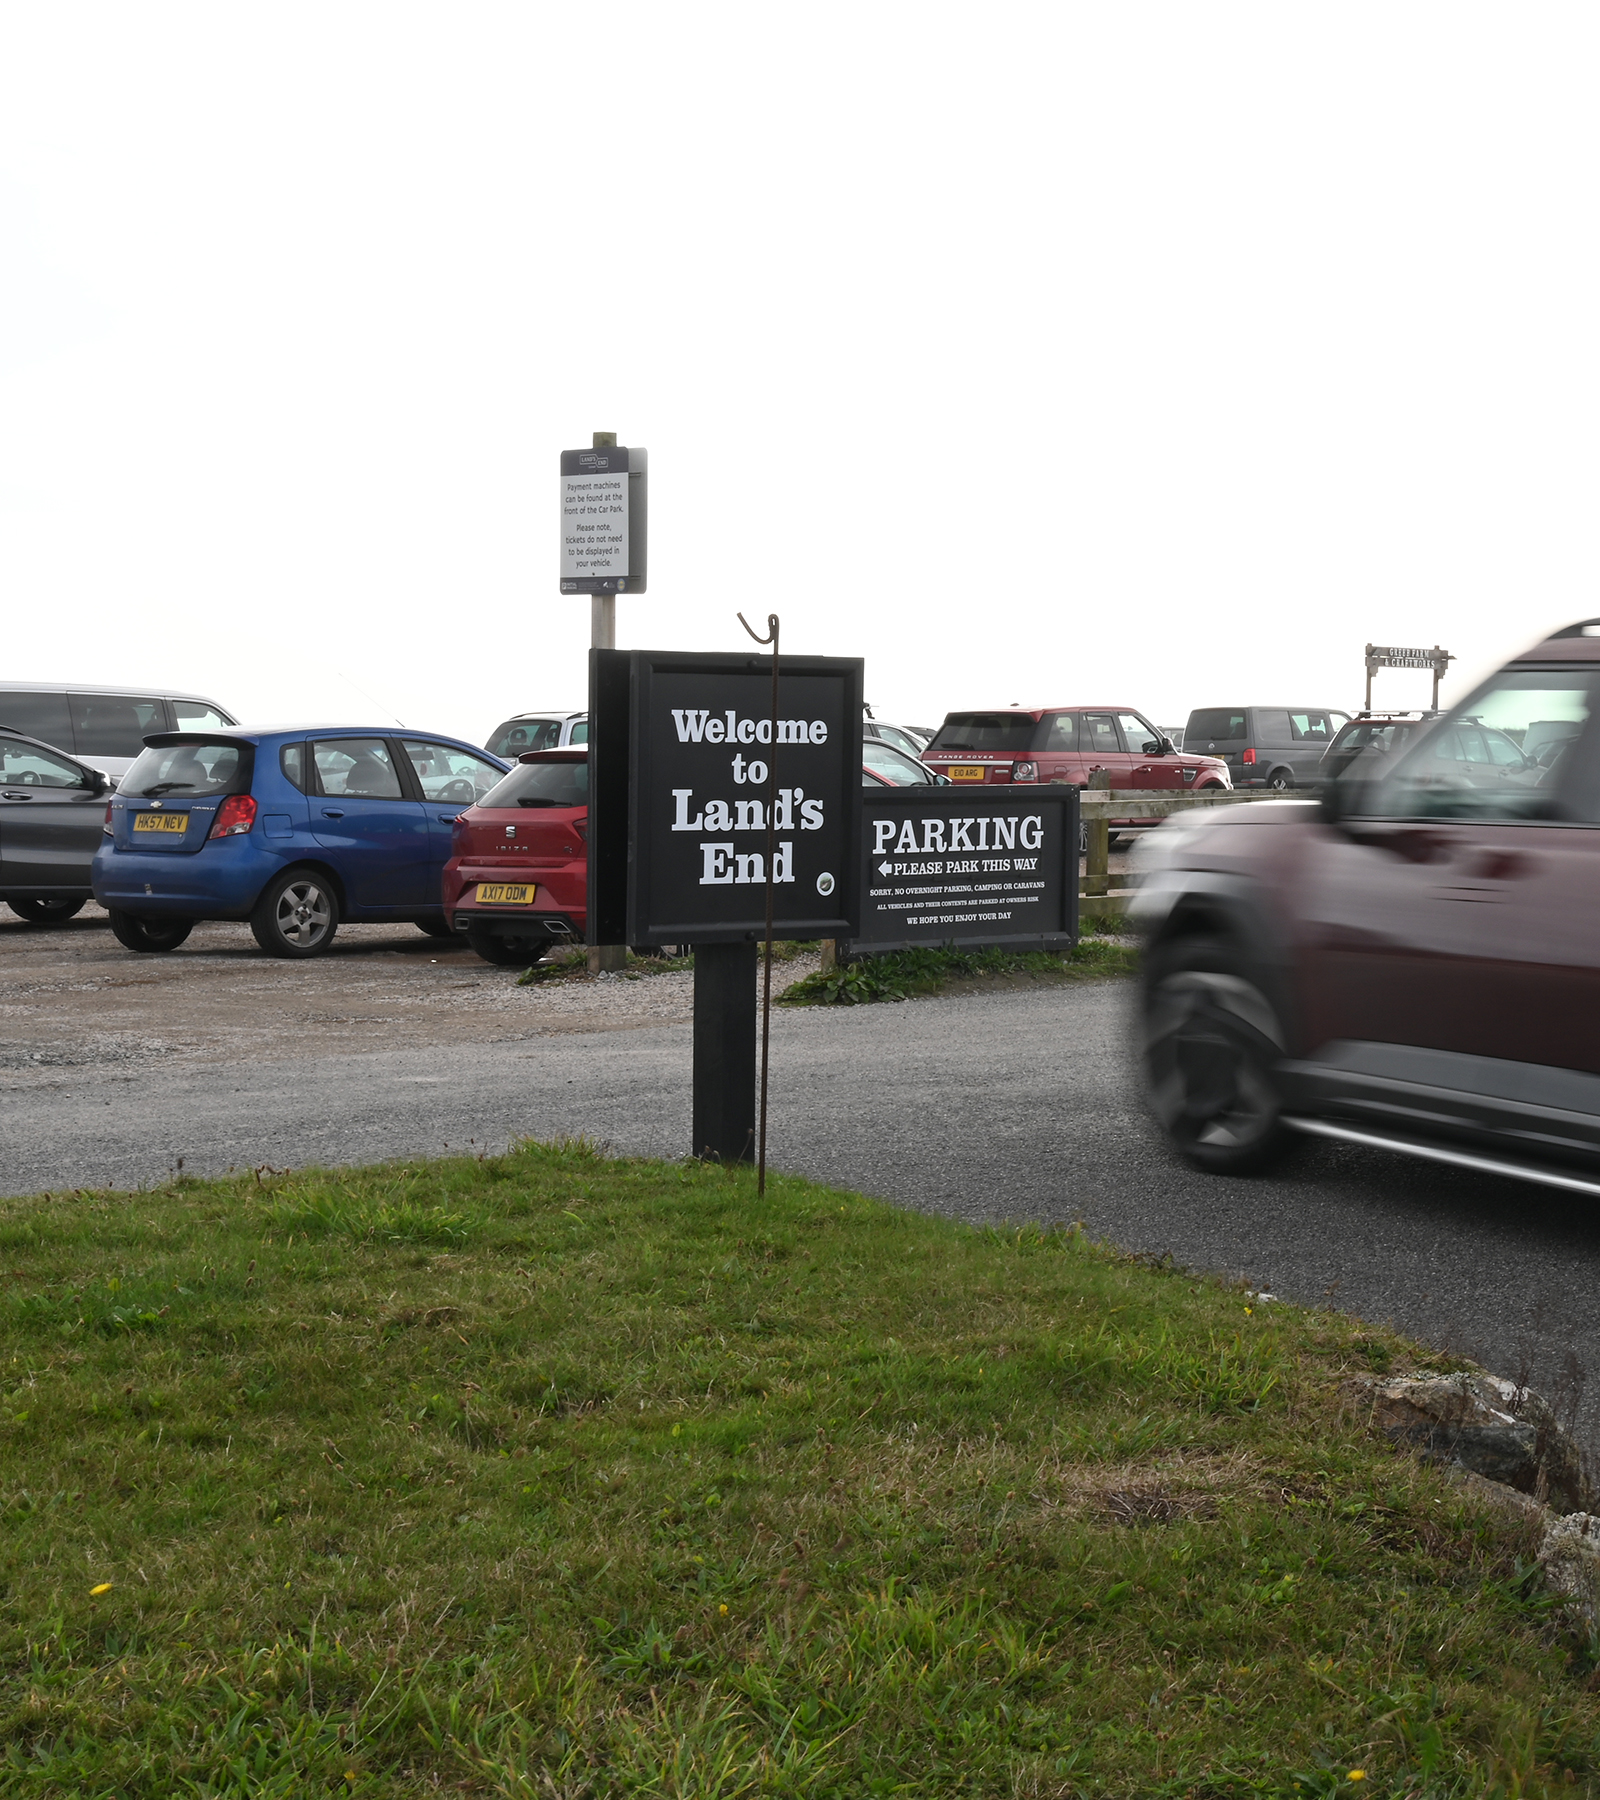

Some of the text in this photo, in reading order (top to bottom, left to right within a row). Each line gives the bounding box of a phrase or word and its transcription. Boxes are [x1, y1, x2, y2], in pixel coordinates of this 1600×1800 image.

[568, 481, 620, 492] Payment machines
[578, 494, 585, 502] be
[586, 494, 603, 502] found
[564, 506, 578, 514] front
[580, 506, 586, 514] of
[588, 506, 597, 514] the
[610, 504, 624, 512] Park.
[566, 536, 586, 544] tickets
[587, 535, 594, 543] do
[608, 534, 622, 542] need
[576, 547, 584, 556] be
[585, 546, 612, 557] displayed
[614, 546, 620, 554] in
[576, 558, 612, 568] your vehicle.
[1412, 649, 1429, 658] FARM
[1392, 659, 1435, 668] CRAFTWORKS
[671, 709, 828, 744] Welcome
[732, 753, 768, 784] to
[671, 788, 824, 832] Land's
[138, 816, 184, 829] HK57 NEV
[872, 816, 1044, 854] PARKING
[699, 842, 796, 885] End
[894, 858, 1038, 876] PLEASE PARK THIS WAY
[482, 886, 504, 900] AX17
[870, 888, 894, 896] SORRY,
[905, 886, 943, 894] OVERNIGHT
[974, 884, 1002, 892] CAMPING
[1014, 882, 1045, 890] CARAVANS
[955, 914, 977, 922] ENJOY
